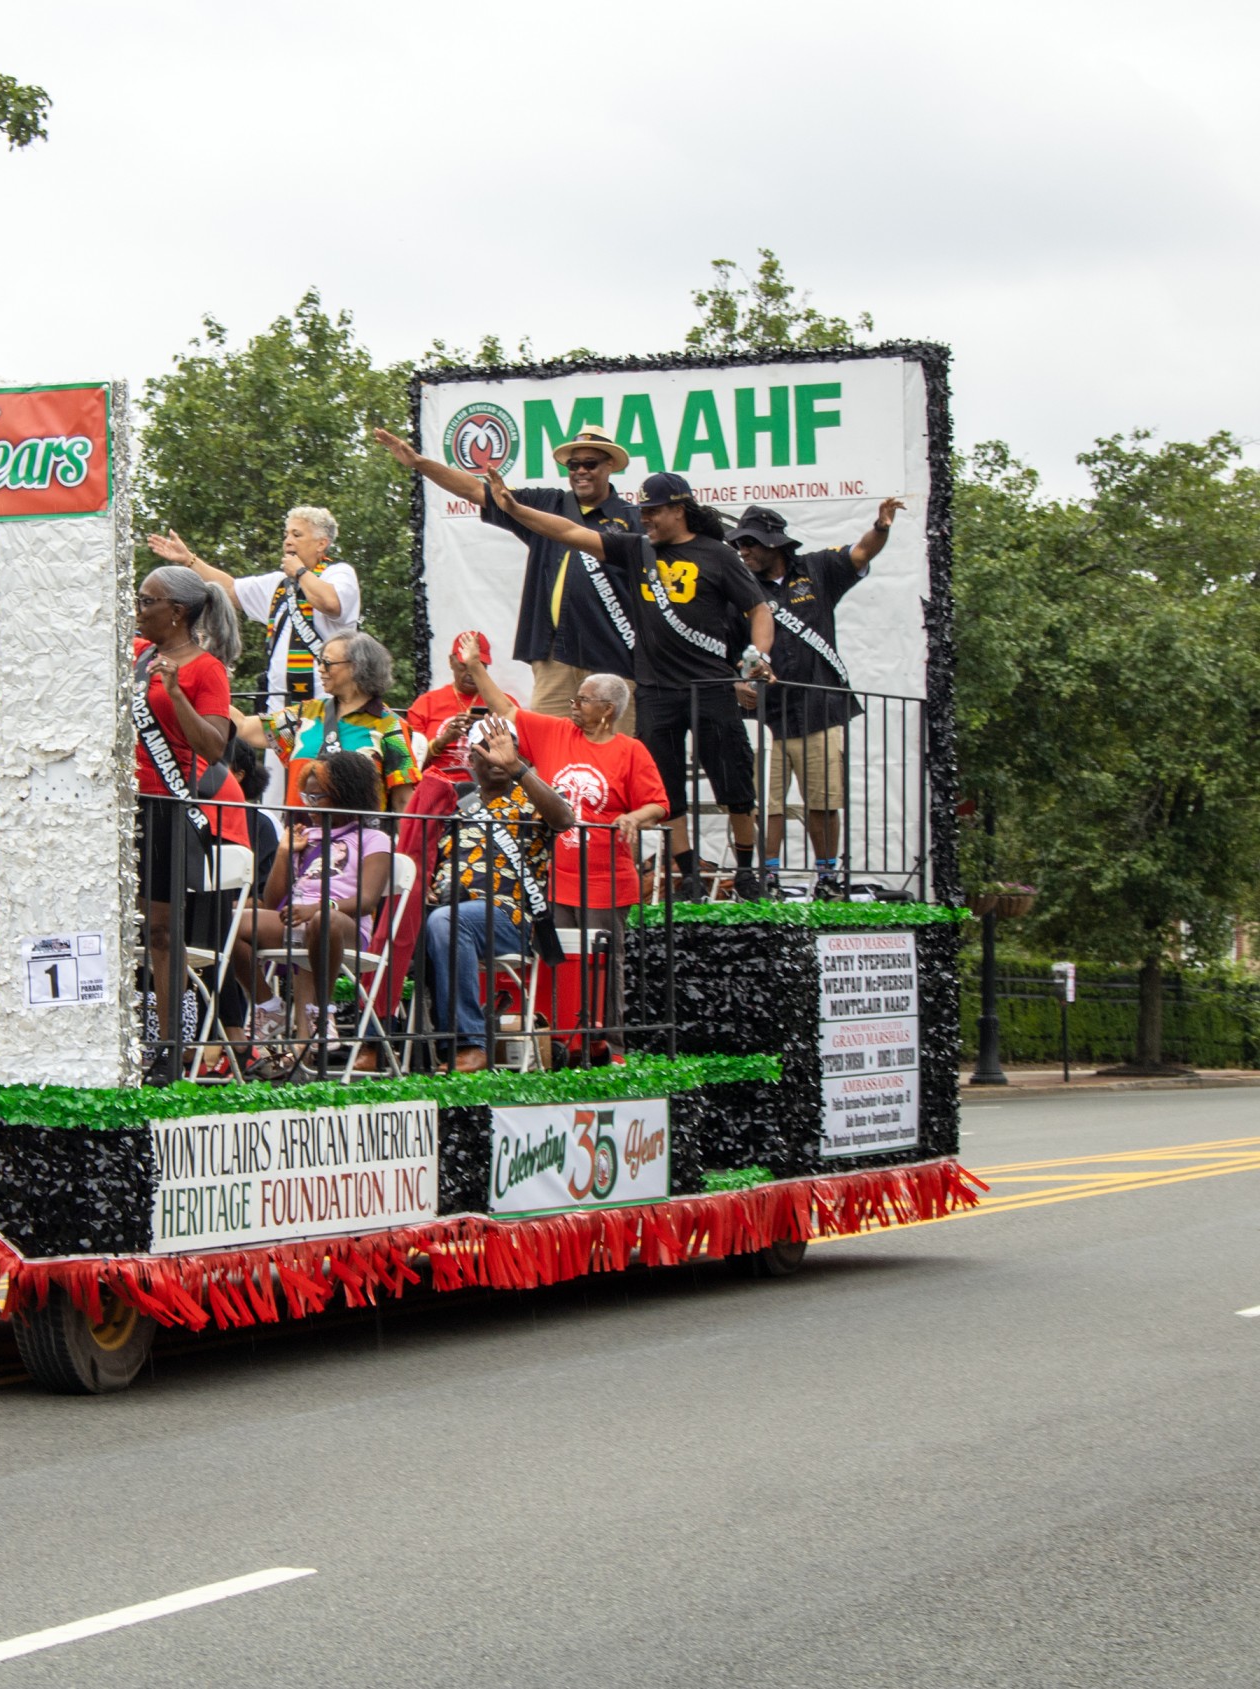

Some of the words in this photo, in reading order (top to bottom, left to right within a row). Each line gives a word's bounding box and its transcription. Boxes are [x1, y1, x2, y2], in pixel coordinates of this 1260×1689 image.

[523, 382, 842, 479] MAAHF
[691, 487, 737, 502] RITAGE
[840, 480, 868, 496] INC.
[662, 609, 727, 658] AMBASSADOR
[774, 607, 805, 634] 2025
[142, 730, 208, 829] AMBASSAOR
[828, 938, 862, 950] GRAND
[44, 963, 60, 998] 1
[824, 955, 855, 972] CATHY
[830, 997, 882, 1016] MONTCLAIR
[832, 1034, 864, 1048] GRAND
[866, 1030, 910, 1045] MARSHALS
[154, 1121, 272, 1181] MONTCLAIRS
[277, 1115, 349, 1170] AFRICAN
[356, 1109, 435, 1163] AMERICAN
[495, 1124, 567, 1199] Celebrating
[568, 1109, 618, 1200] 35
[624, 1119, 665, 1180] Years
[161, 1181, 252, 1239] HERITAGE
[395, 1166, 431, 1213] INC.
